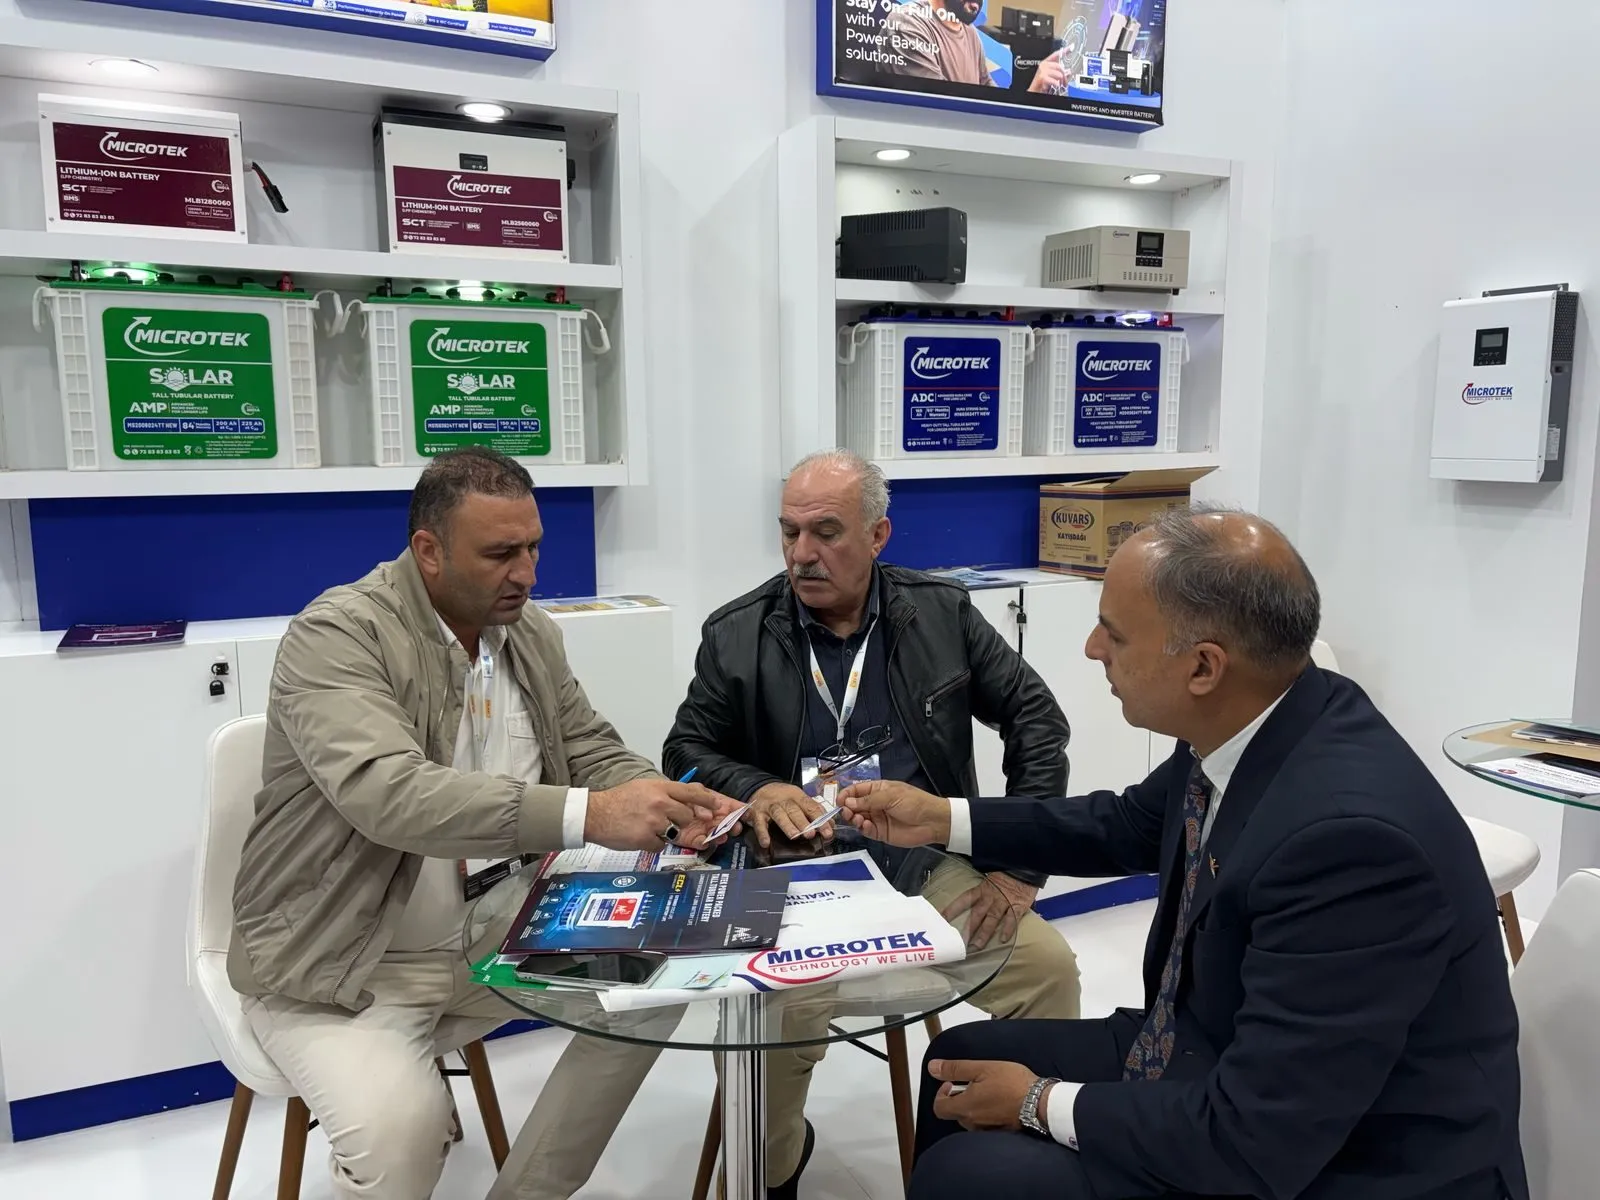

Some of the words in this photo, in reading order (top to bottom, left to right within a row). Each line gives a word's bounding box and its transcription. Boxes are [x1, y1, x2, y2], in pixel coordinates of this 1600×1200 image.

[908, 2, 933, 19] Full
[936, 7, 960, 23] On.
[846, 11, 875, 28] with
[879, 18, 900, 31] our
[846, 28, 888, 46] Power
[891, 35, 940, 56] Backup
[846, 46, 908, 67] solutions.
[1071, 103, 1098, 112] INVERTERS
[1110, 108, 1134, 117] INVERTER
[1134, 110, 1156, 119] BATTERY
[107, 138, 188, 158] MICROTEK
[60, 166, 118, 178] LITHIUM-ION
[119, 171, 160, 181] BATTERY
[62, 184, 88, 192] SCT
[452, 181, 512, 195] MICROTEK
[184, 197, 231, 207] MLB1280060
[402, 202, 448, 211] LITHIUM-ION
[449, 205, 483, 214] BATTERY
[402, 218, 426, 226] SCT
[134, 329, 251, 347] MICROTEK
[436, 339, 530, 353] MICROTEK
[917, 357, 991, 370] MICROTEK
[1088, 360, 1153, 371] MICROTEK
[150, 367, 234, 385] SOLAR
[447, 372, 516, 388] SOLAR
[911, 393, 934, 402] ADC
[1081, 393, 1103, 402] ADC
[1467, 386, 1513, 396] MICROTEK
[129, 402, 167, 413] AMP
[429, 404, 461, 415] AMP
[1056, 512, 1090, 525] KUVARS
[700, 902, 714, 922] BATTERY
[767, 931, 932, 965] MICROTEK
[771, 957, 869, 974] TECHNOLOGY
[877, 955, 898, 964] WE
[905, 952, 936, 963] LIVE
